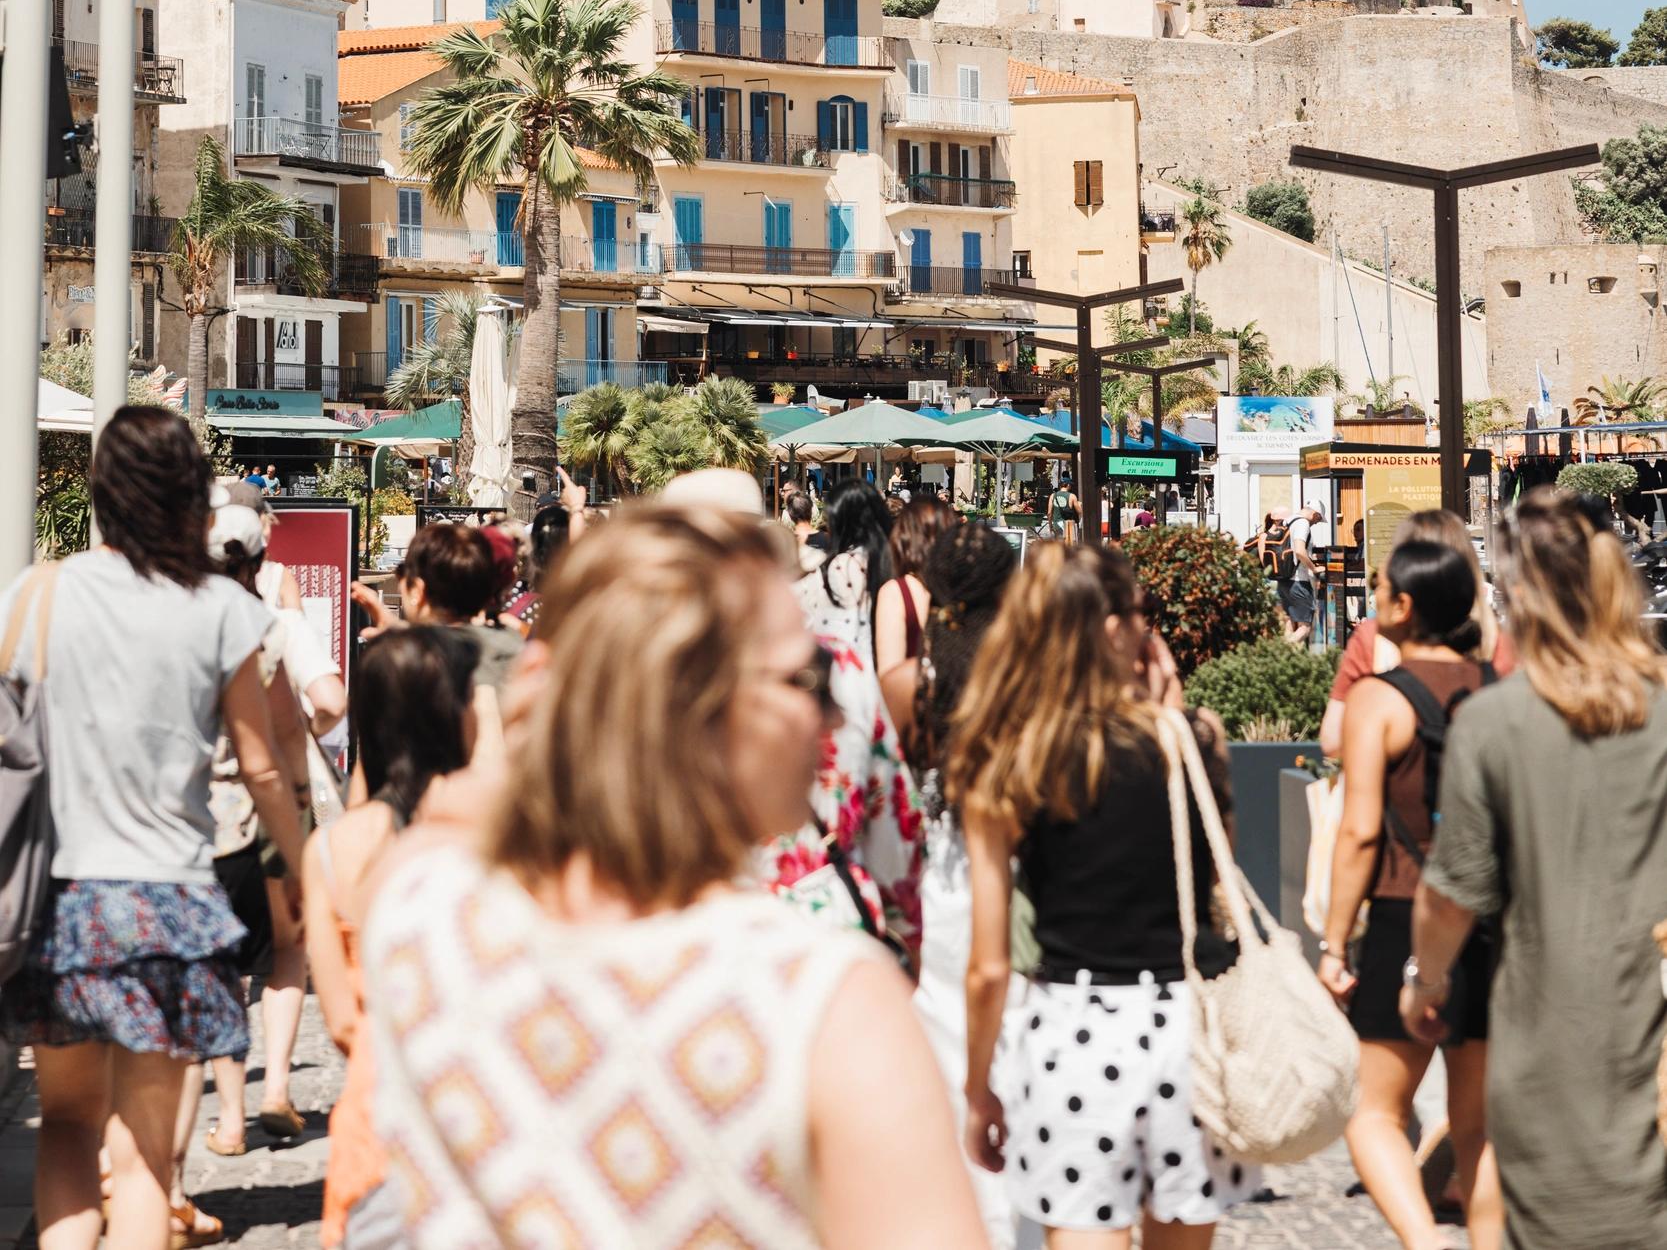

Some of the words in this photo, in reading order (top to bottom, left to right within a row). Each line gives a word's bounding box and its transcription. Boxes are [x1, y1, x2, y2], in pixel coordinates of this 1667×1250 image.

[1121, 457, 1164, 467] Excursions
[1335, 456, 1411, 466] PROMENADES
[1414, 456, 1428, 466] EN
[1388, 485, 1399, 493] LA
[1402, 493, 1441, 501] PLASTIQU
